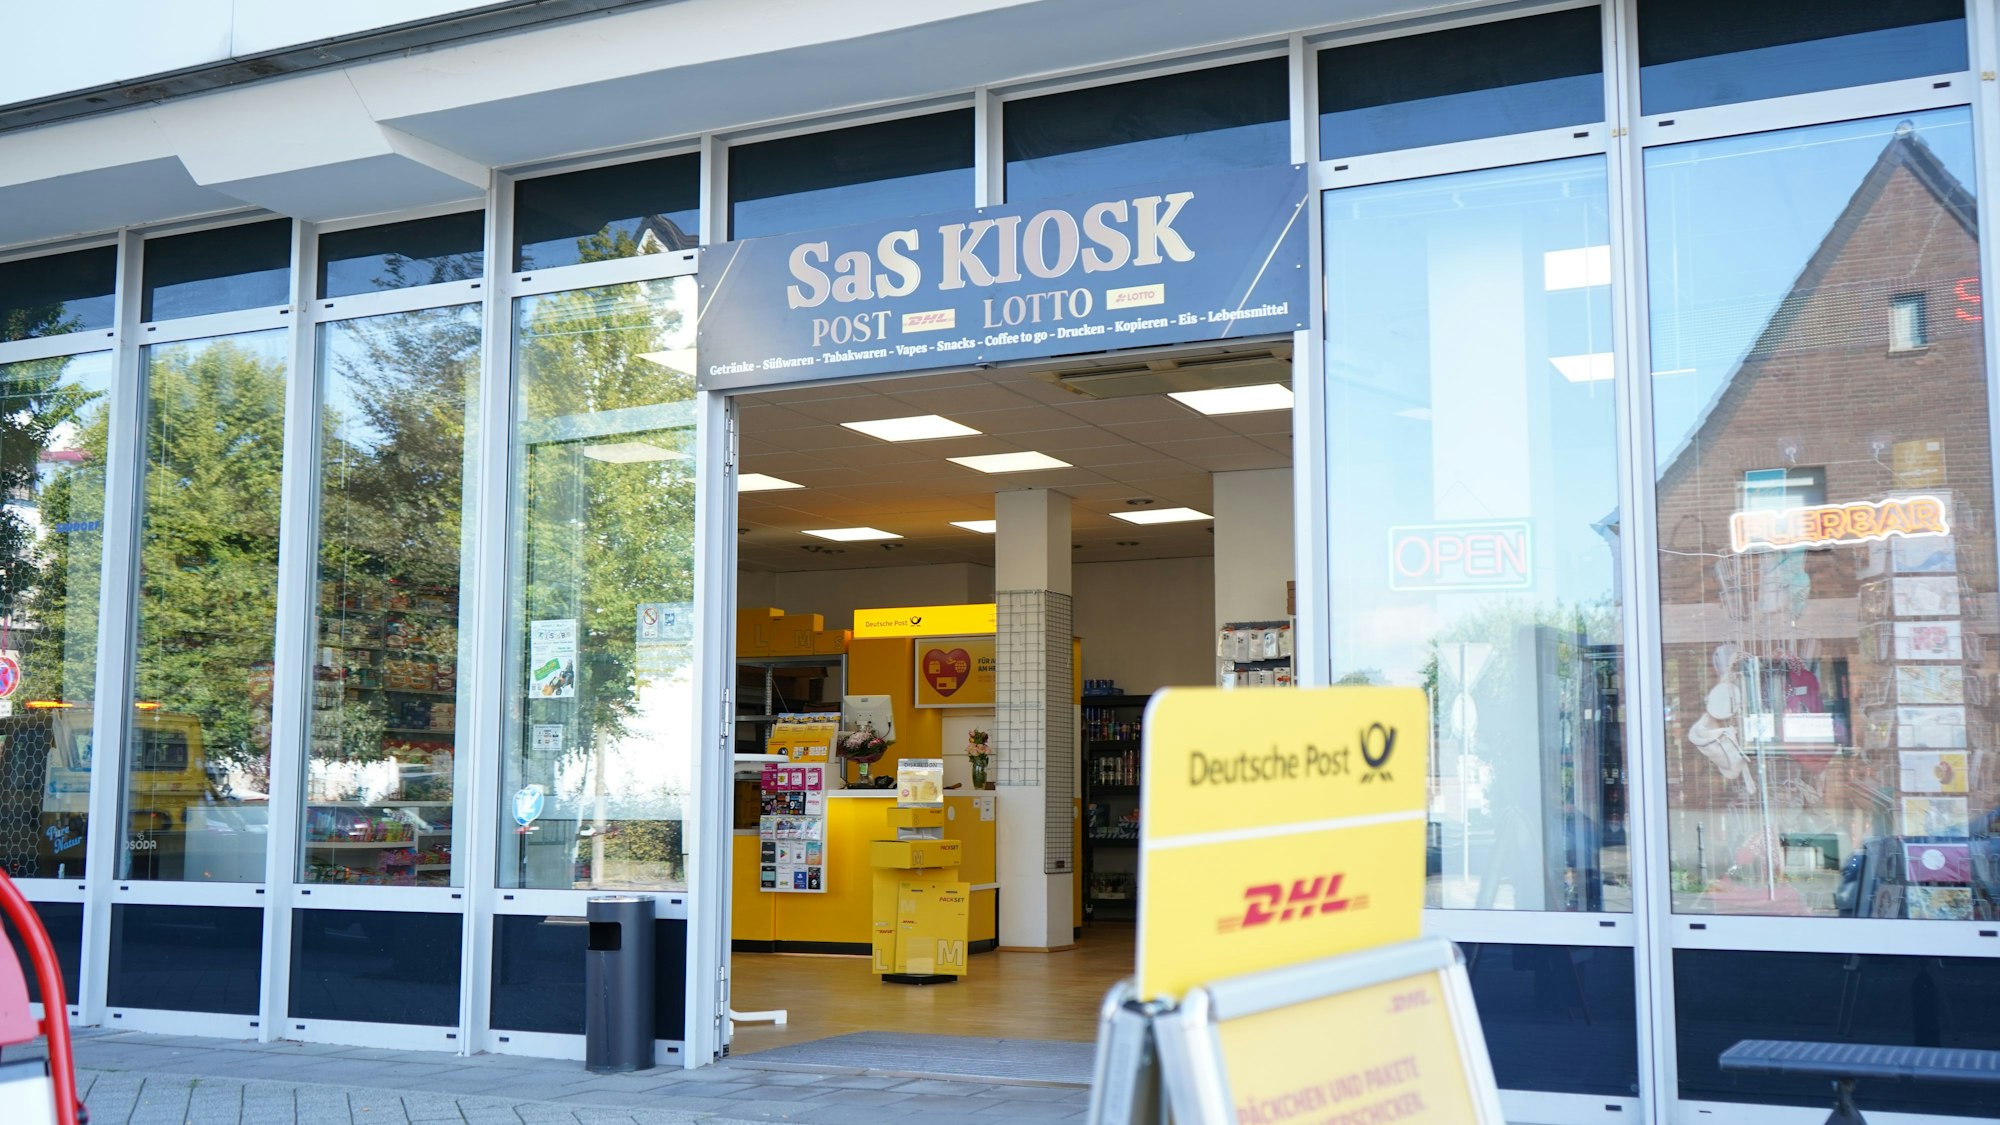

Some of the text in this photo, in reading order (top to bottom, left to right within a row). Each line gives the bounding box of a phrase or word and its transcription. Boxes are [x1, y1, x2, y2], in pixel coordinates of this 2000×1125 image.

[786, 191, 1196, 309] SaS KIOSK
[983, 288, 1093, 328] LOTTO
[1127, 291, 1155, 302] LOTTO
[811, 310, 891, 347] POST
[907, 313, 948, 326] DHL
[709, 362, 755, 376] Getränke
[763, 357, 814, 370] Süßwaren
[823, 348, 887, 364] Tabakwaren
[896, 343, 928, 358] Vapes
[936, 337, 976, 351] Snacks
[984, 331, 1019, 347] Coffee
[1020, 332, 1032, 343] to
[1034, 331, 1048, 344] go
[1057, 324, 1105, 339] Drucken
[1115, 316, 1168, 333] Kopieren
[1178, 312, 1198, 326] Eis
[1208, 302, 1289, 323] Lebensmittel
[1394, 532, 1528, 578] OPEN
[1189, 744, 1351, 786] Deutsche Post
[46, 825, 70, 840] Pure
[54, 836, 82, 854] Natur
[1242, 872, 1351, 929] DHL
[874, 949, 889, 972] L
[936, 938, 964, 967] M
[1328, 1072, 1365, 1103] UND
[1364, 1055, 1422, 1094] PAKETE
